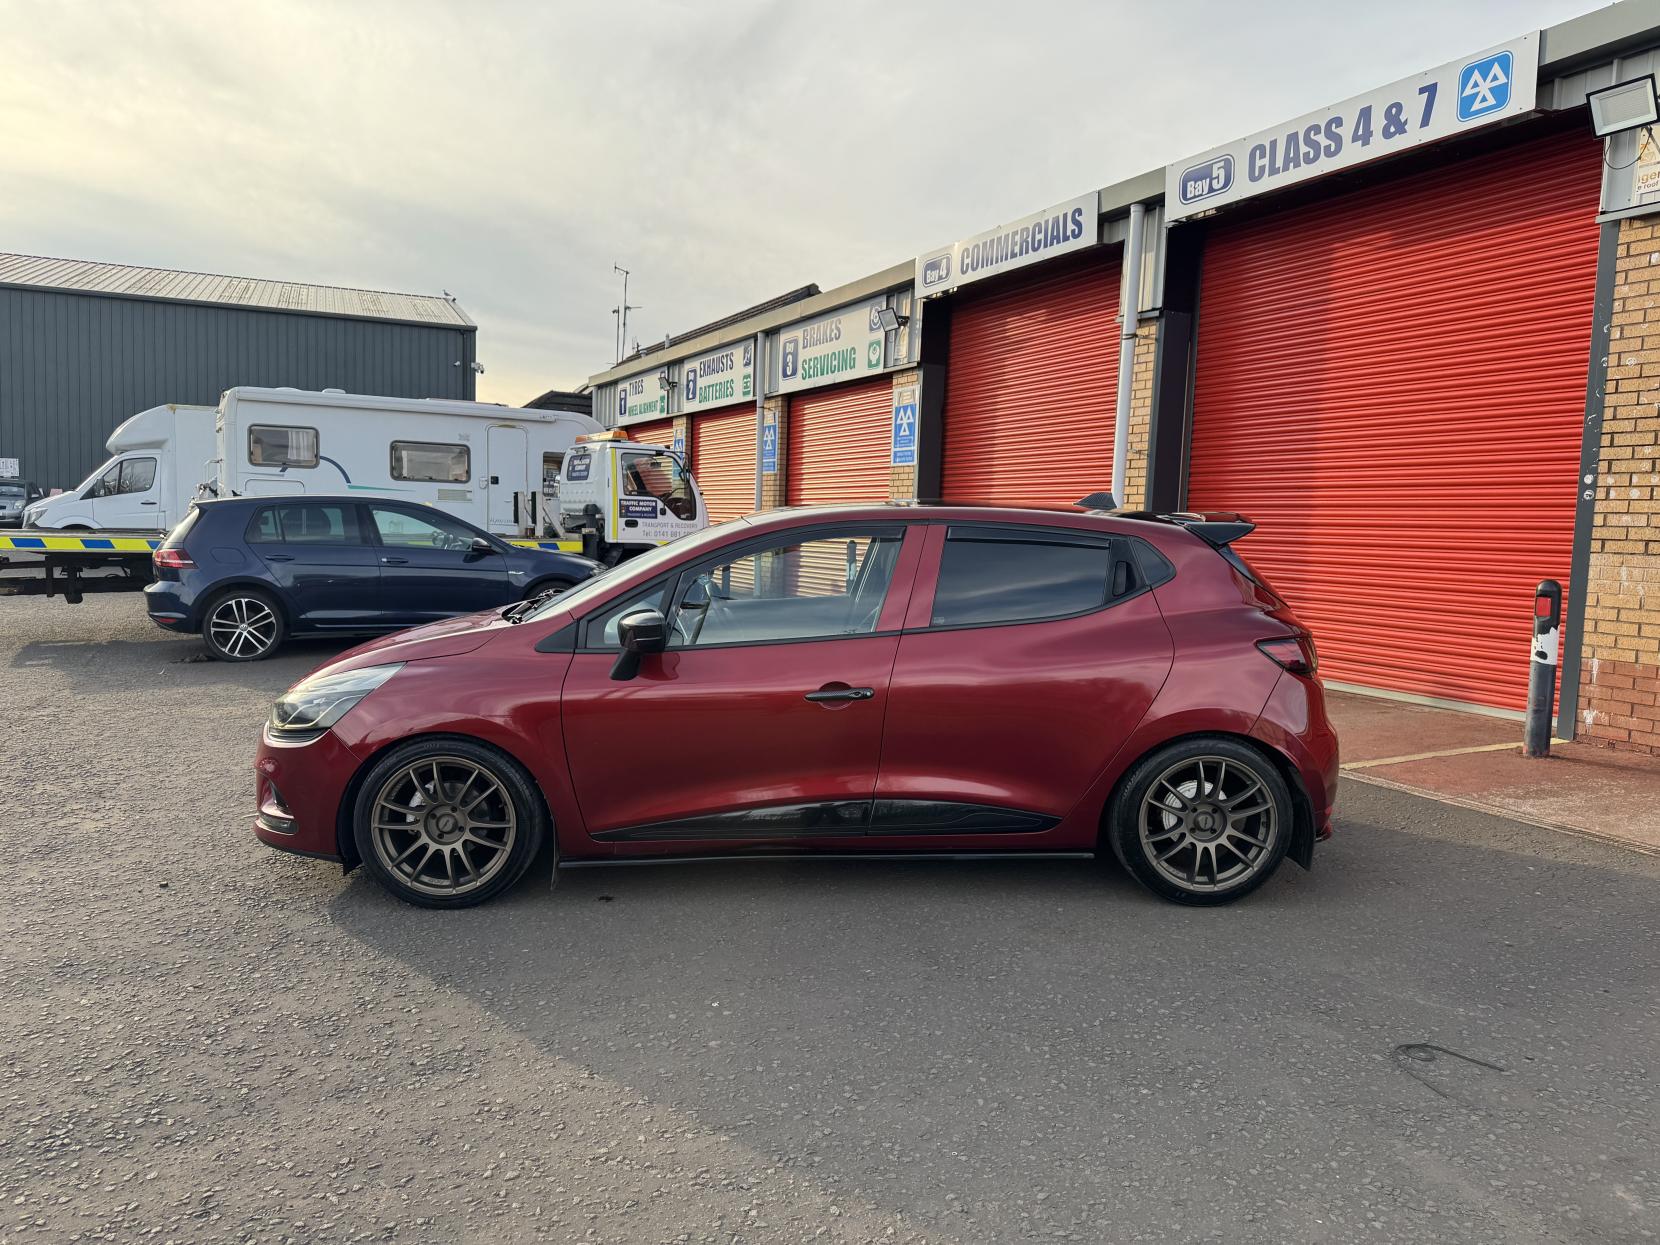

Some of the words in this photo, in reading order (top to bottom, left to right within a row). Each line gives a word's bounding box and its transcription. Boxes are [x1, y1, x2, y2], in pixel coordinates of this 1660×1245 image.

[1248, 116, 1344, 183] CLASS
[1351, 104, 1374, 148] 4
[1381, 101, 1409, 140] &
[1418, 82, 1439, 129] 7
[1186, 177, 1210, 199] Bay
[1211, 160, 1226, 190] 5
[960, 207, 1083, 276] COMMERCIALS
[926, 267, 939, 284] Bay
[939, 257, 948, 279] 4
[802, 318, 841, 350] BRAKES
[699, 351, 734, 378] EXHAUSTS
[786, 354, 793, 376] 3
[801, 346, 857, 380] SERVICING
[688, 381, 694, 399] 2
[698, 378, 735, 404] BATTERIES
[642, 521, 669, 529] TRANSPORT
